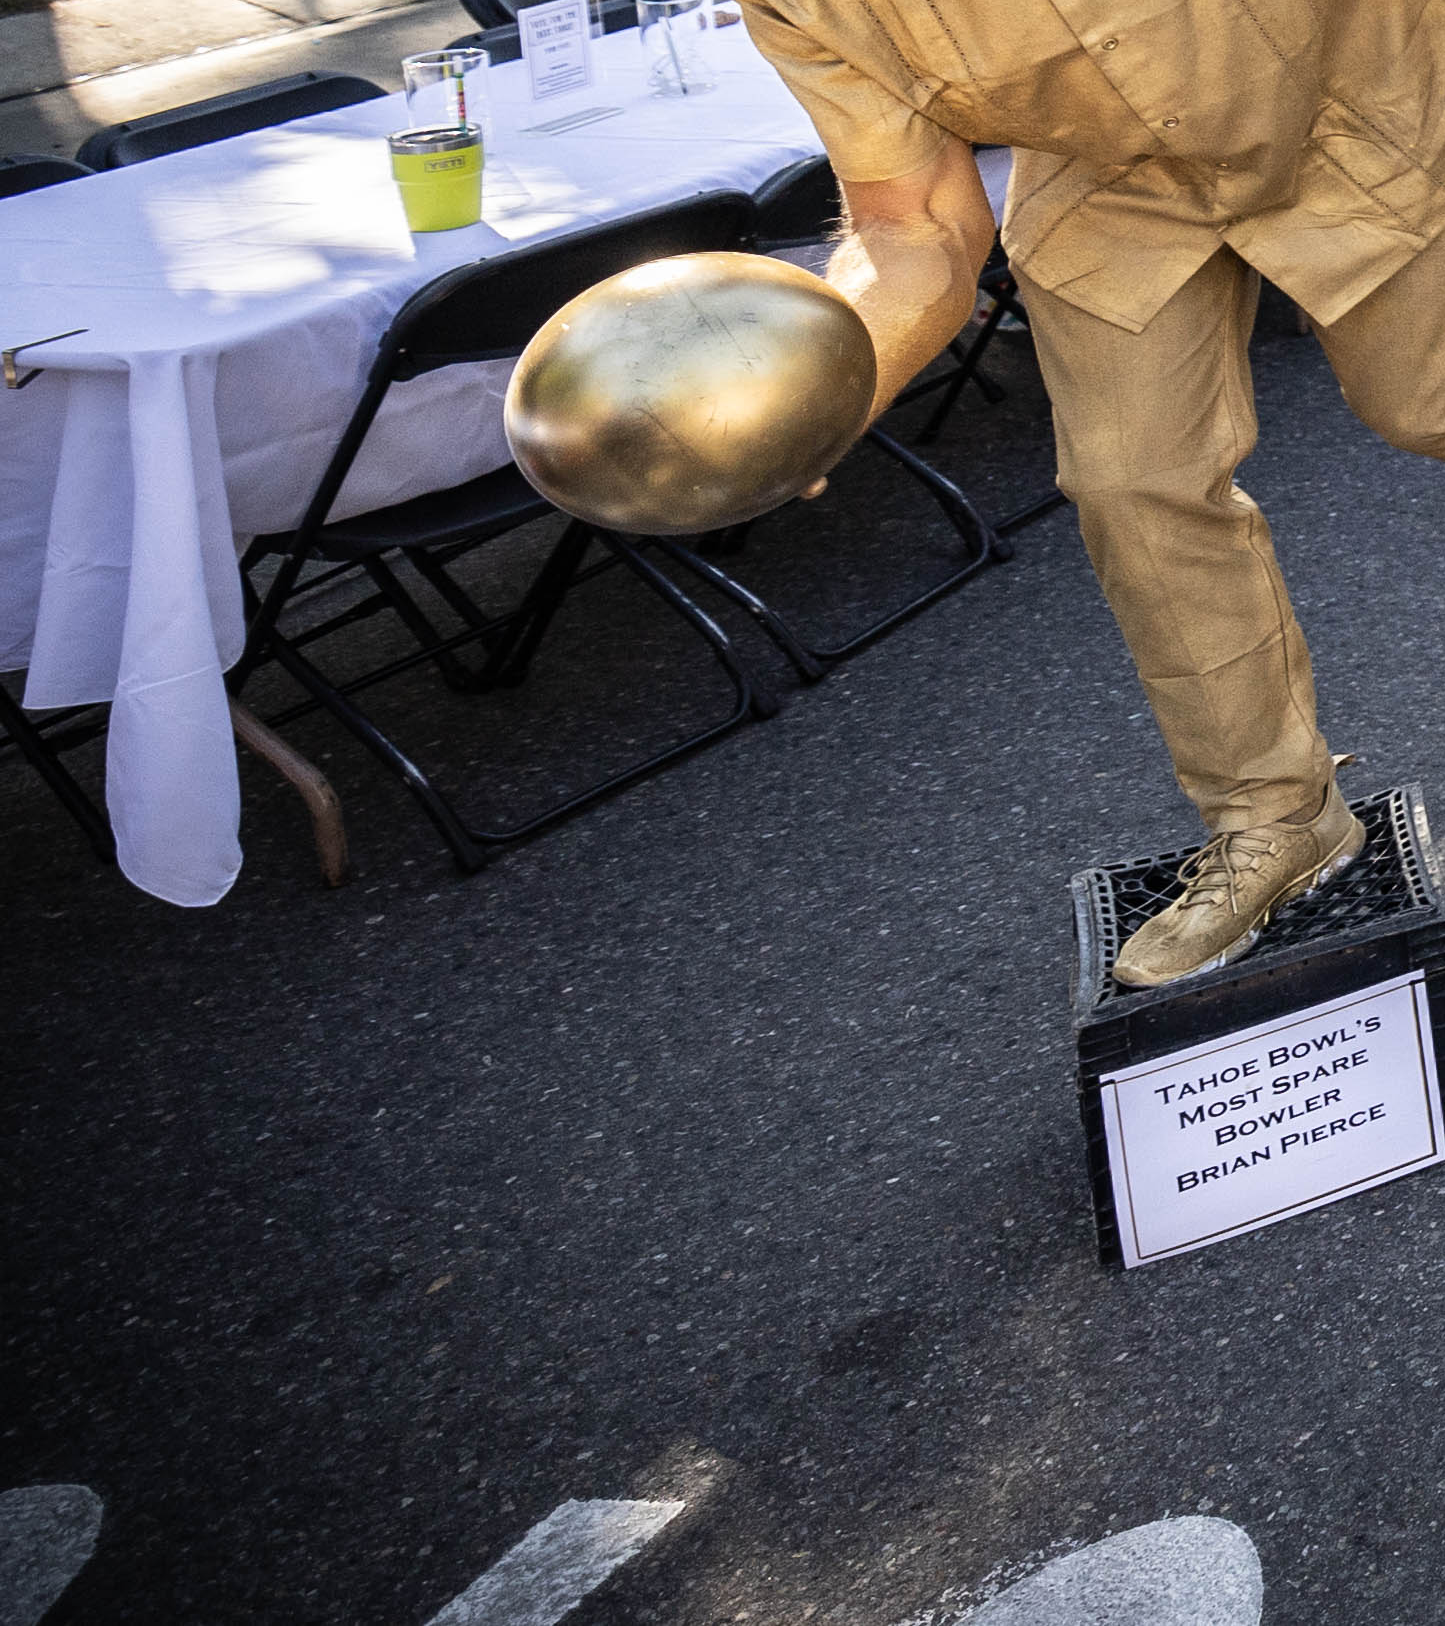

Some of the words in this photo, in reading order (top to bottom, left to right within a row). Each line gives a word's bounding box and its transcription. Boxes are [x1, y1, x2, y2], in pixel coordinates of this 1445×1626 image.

[1154, 1058, 1260, 1105] TAHOE
[1268, 1016, 1382, 1068] BOWL'S
[1178, 1086, 1263, 1130] MOST
[1271, 1048, 1369, 1095] SPARE
[1176, 1145, 1271, 1193] BRIAN
[1280, 1102, 1386, 1155] PIERCE
[1214, 1088, 1342, 1147] BOWLER
